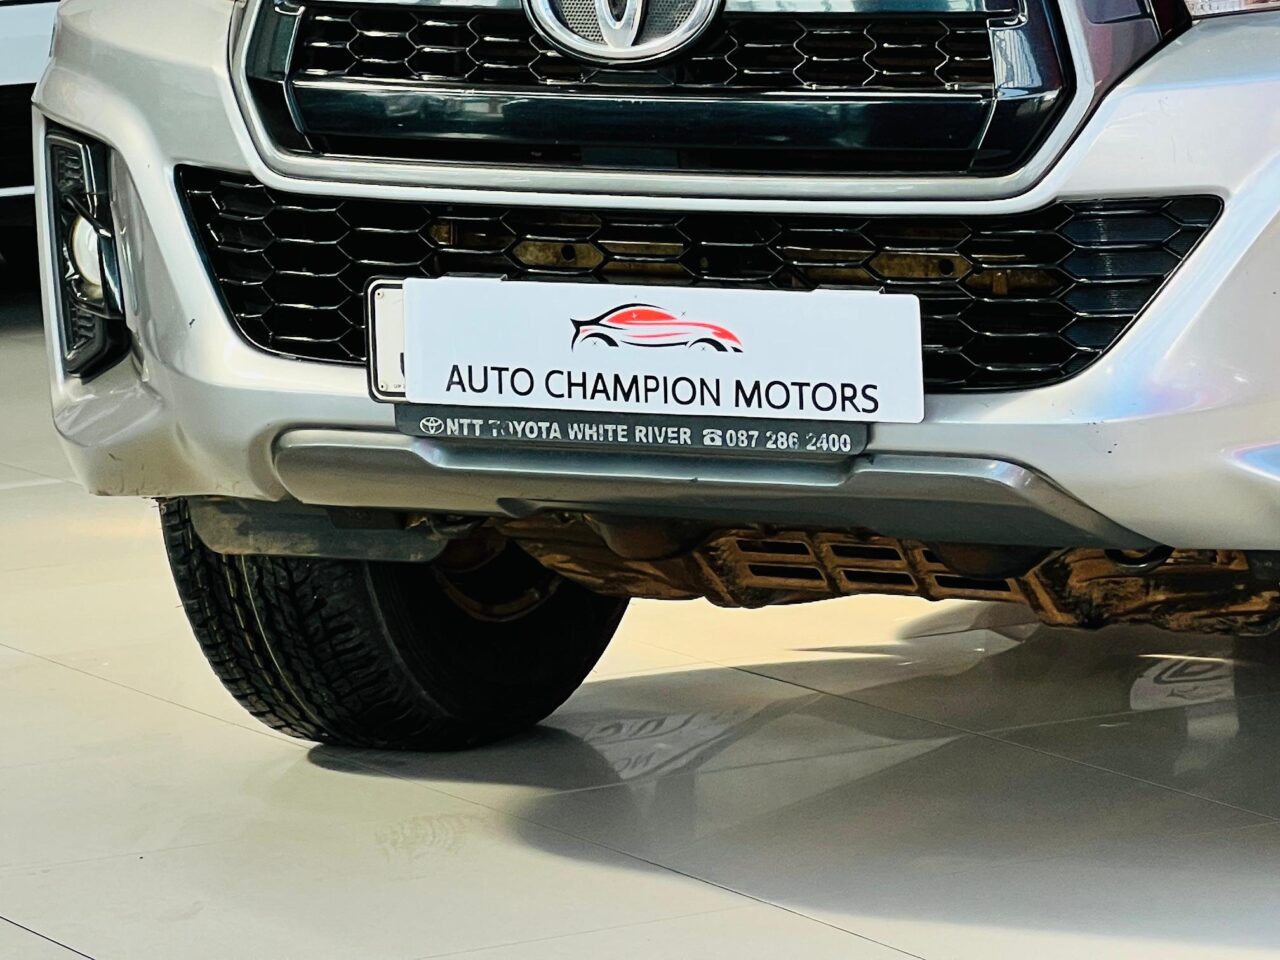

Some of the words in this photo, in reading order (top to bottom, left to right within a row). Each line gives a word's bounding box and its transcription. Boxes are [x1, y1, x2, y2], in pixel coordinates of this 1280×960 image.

[445, 364, 535, 397] AUTO
[544, 369, 721, 407] CHAMPION
[734, 379, 879, 414] MOTORS
[446, 418, 484, 437] NTT
[567, 423, 629, 442] WHITE
[634, 425, 692, 445] RIVER
[725, 429, 759, 448] 087
[765, 430, 799, 450] 286
[805, 432, 851, 453] 2400
